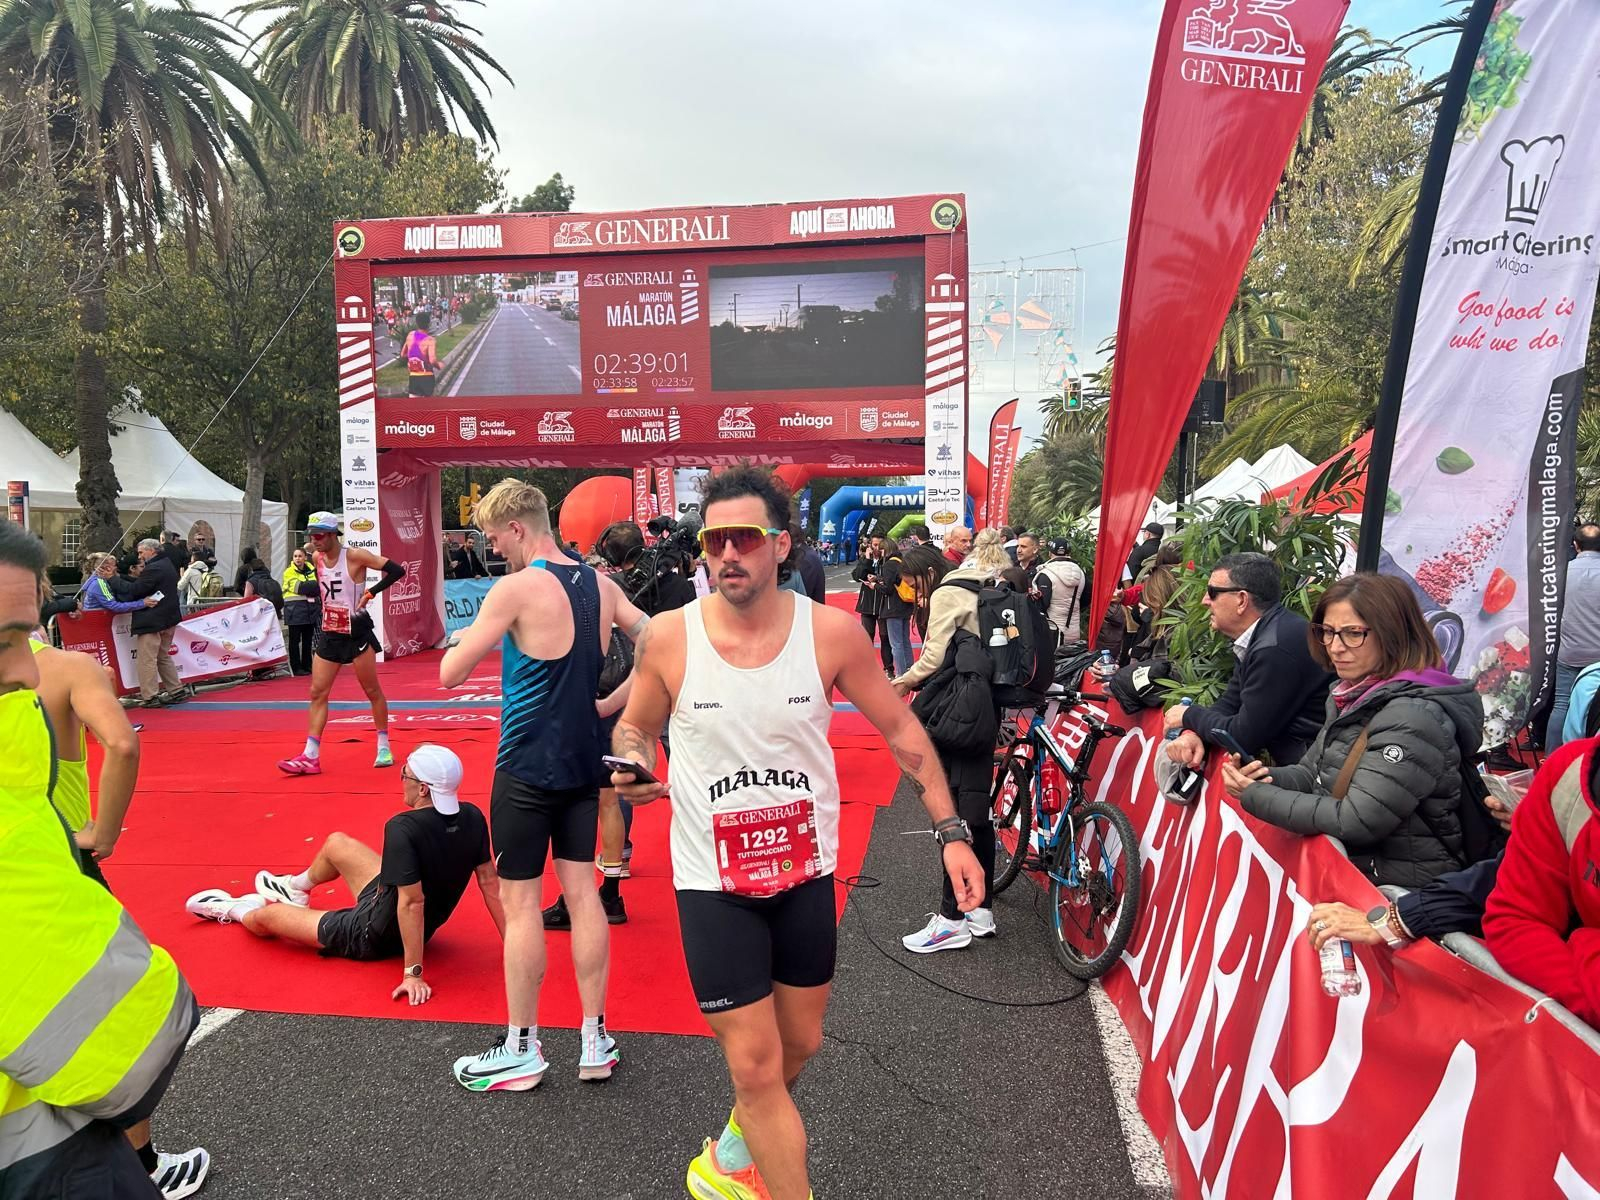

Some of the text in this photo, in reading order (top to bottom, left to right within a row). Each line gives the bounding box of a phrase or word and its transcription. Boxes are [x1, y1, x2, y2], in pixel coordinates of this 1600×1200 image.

[1181, 57, 1305, 94] GENERALI
[790, 205, 896, 237] AQUÍ AHORA
[404, 223, 502, 255] AQUÍ AHORA
[595, 215, 731, 246] GENERALI
[1512, 231, 1594, 257] Cterin
[604, 271, 673, 286] GENERALI
[638, 290, 673, 303] MARATÓN
[606, 301, 677, 327] MÁLAGA
[1458, 291, 1575, 327] Goo food is
[1450, 326, 1487, 349] wht
[1490, 337, 1518, 352] we
[594, 352, 688, 375] 02:39:01
[593, 378, 638, 389] 02:33:58
[651, 377, 694, 387] 02:23:57
[620, 408, 665, 418] GENERALI
[780, 411, 833, 430] málaga
[882, 411, 909, 419] Ciudad
[384, 420, 435, 437] málaga
[480, 420, 505, 428] Ciudad
[893, 419, 920, 428] Málaga
[480, 428, 517, 437] de Málaga
[538, 434, 575, 443] GENERALI
[621, 426, 667, 443] MÁLAGA
[718, 430, 757, 440] GENERALI
[863, 490, 925, 506] luanvi
[788, 696, 812, 705] FOSK
[739, 803, 801, 825] GENERALI
[739, 826, 789, 849] 1292
[737, 844, 792, 860] TUTTOPUCCIATO
[1077, 727, 1600, 1200] GENERA
